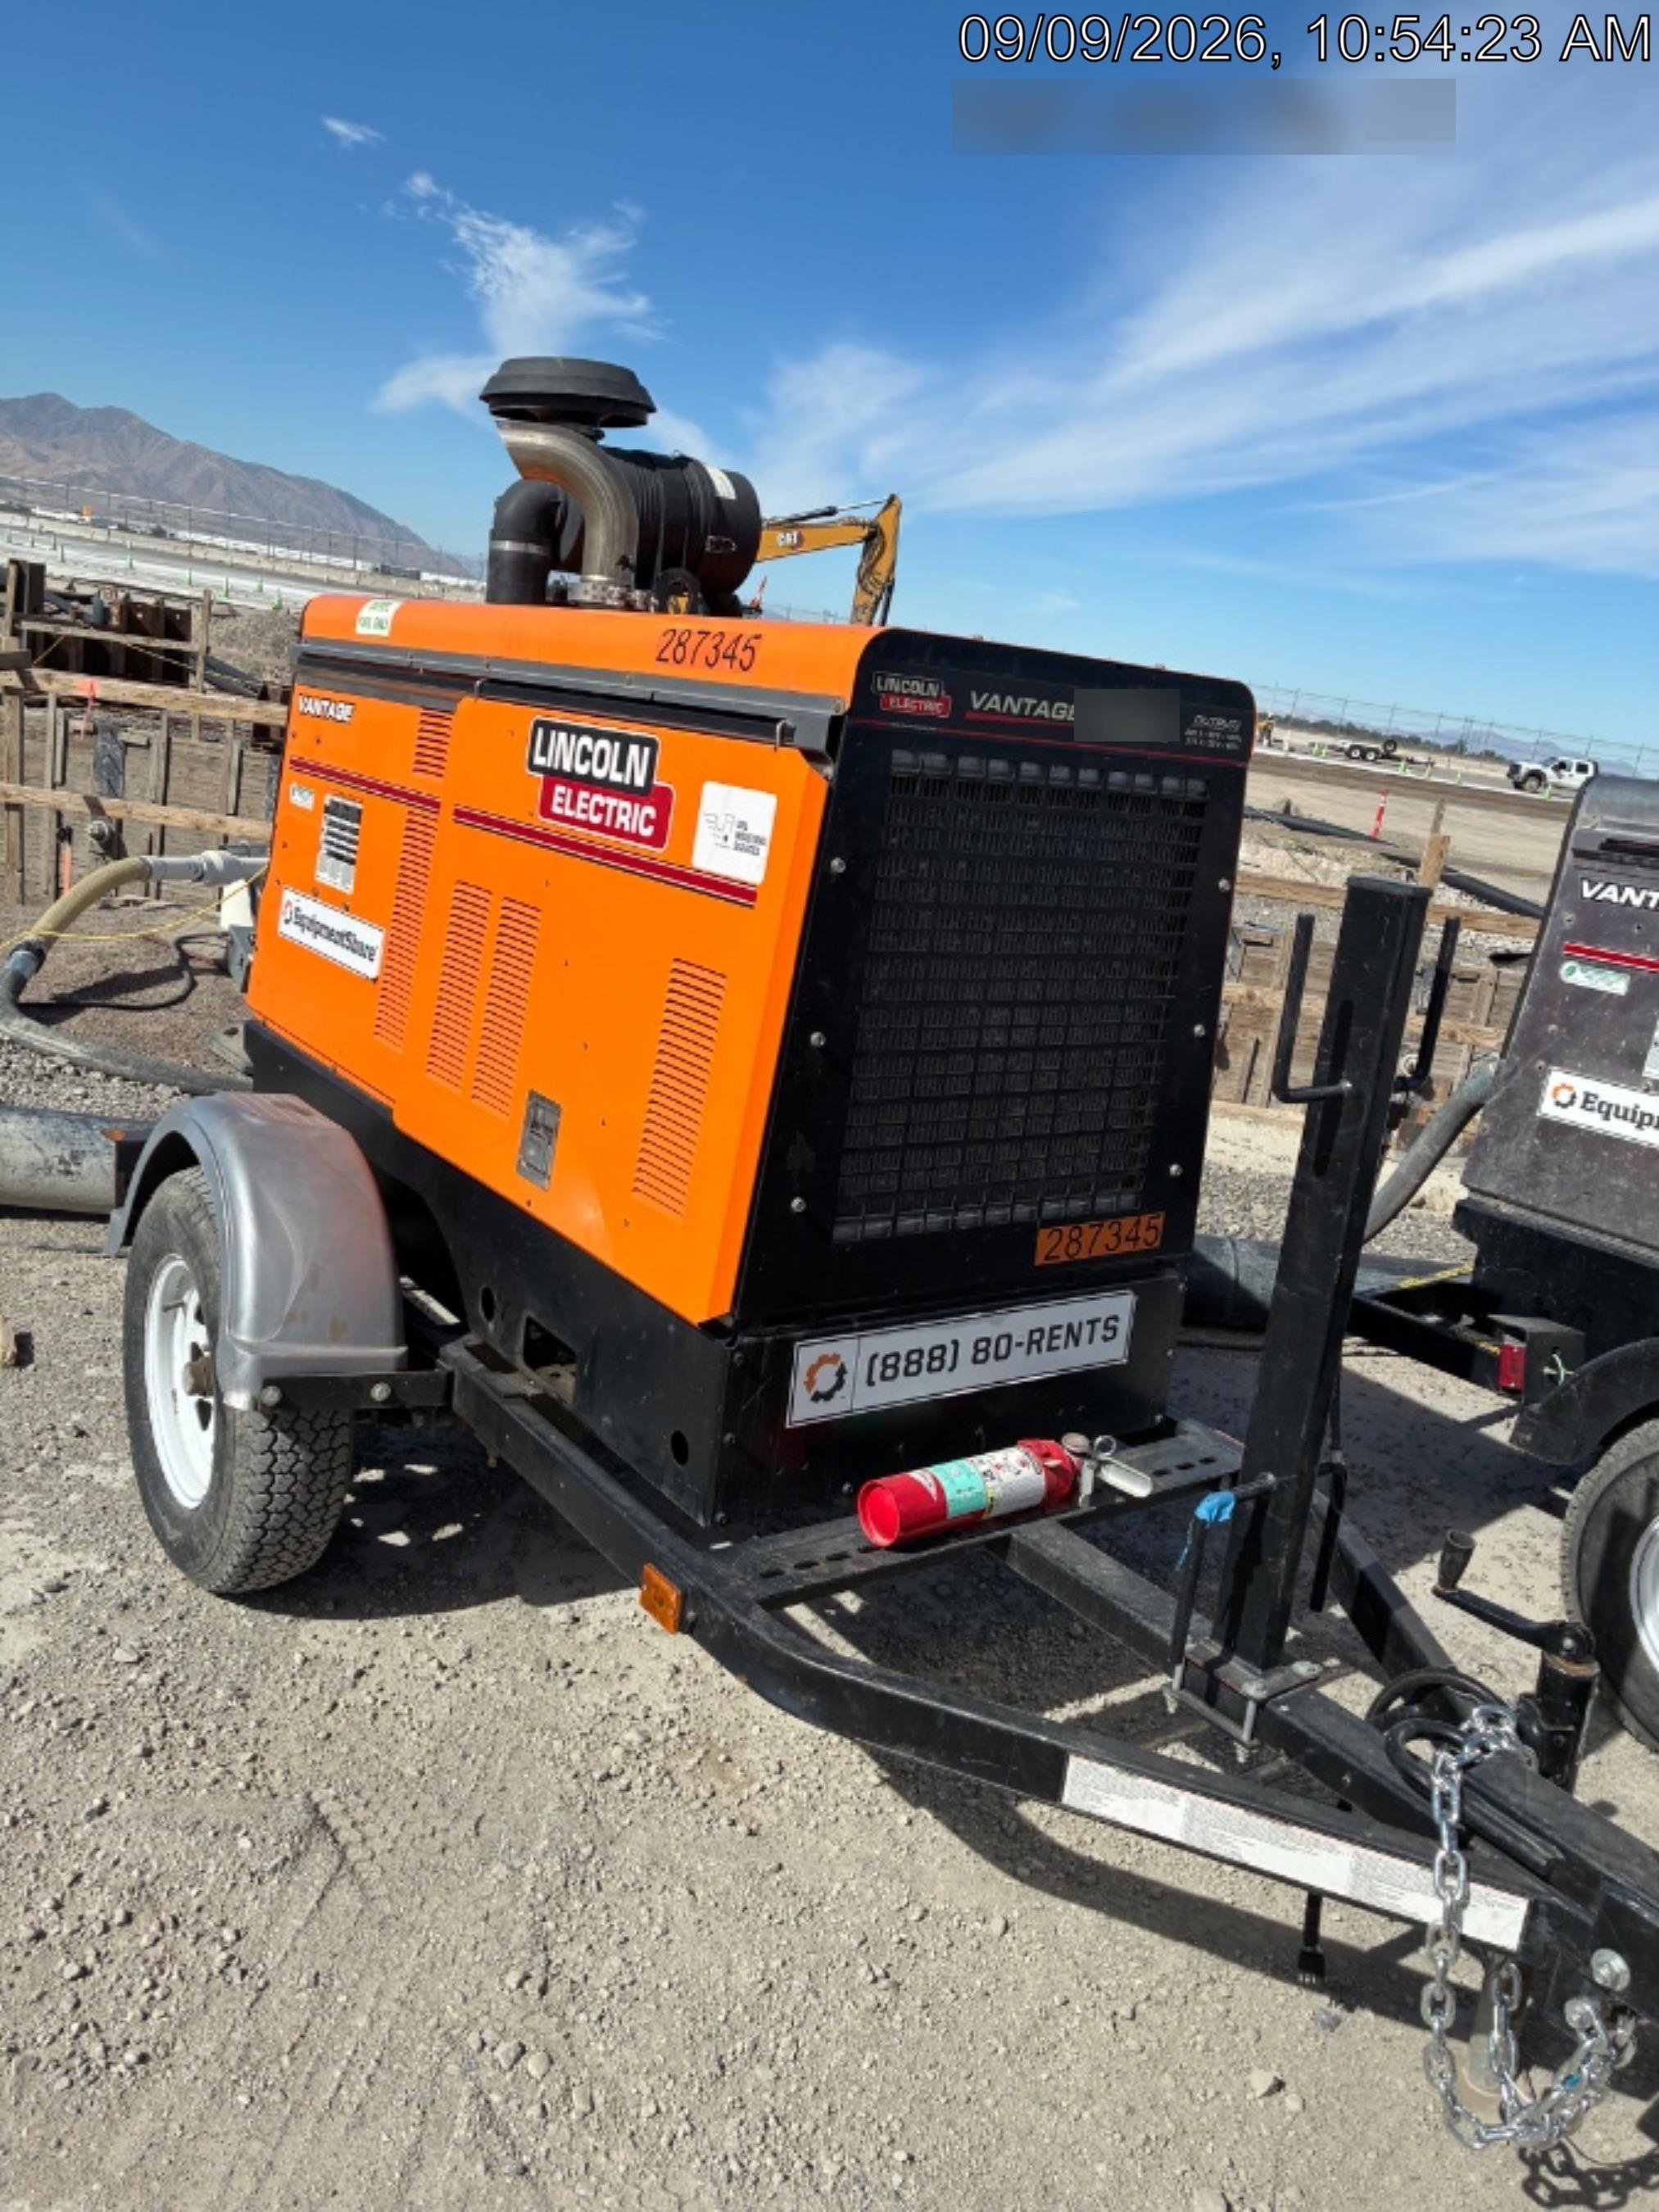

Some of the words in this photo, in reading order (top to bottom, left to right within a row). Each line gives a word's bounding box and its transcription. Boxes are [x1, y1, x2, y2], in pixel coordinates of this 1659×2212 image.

[656, 629, 762, 672] 287345
[876, 675, 940, 697] LINCOLN
[889, 696, 945, 714] ELECTRIC
[298, 696, 355, 723] VANTAGE
[533, 726, 651, 786] LINCOLN
[551, 784, 656, 837] ELECTRIC
[293, 905, 377, 963] EquipmentShare
[1580, 1090, 1659, 1131] Equip
[1044, 1217, 1161, 1262] 287345
[865, 1339, 960, 1387] (888)
[972, 1314, 1120, 1365] 80-RENTS
